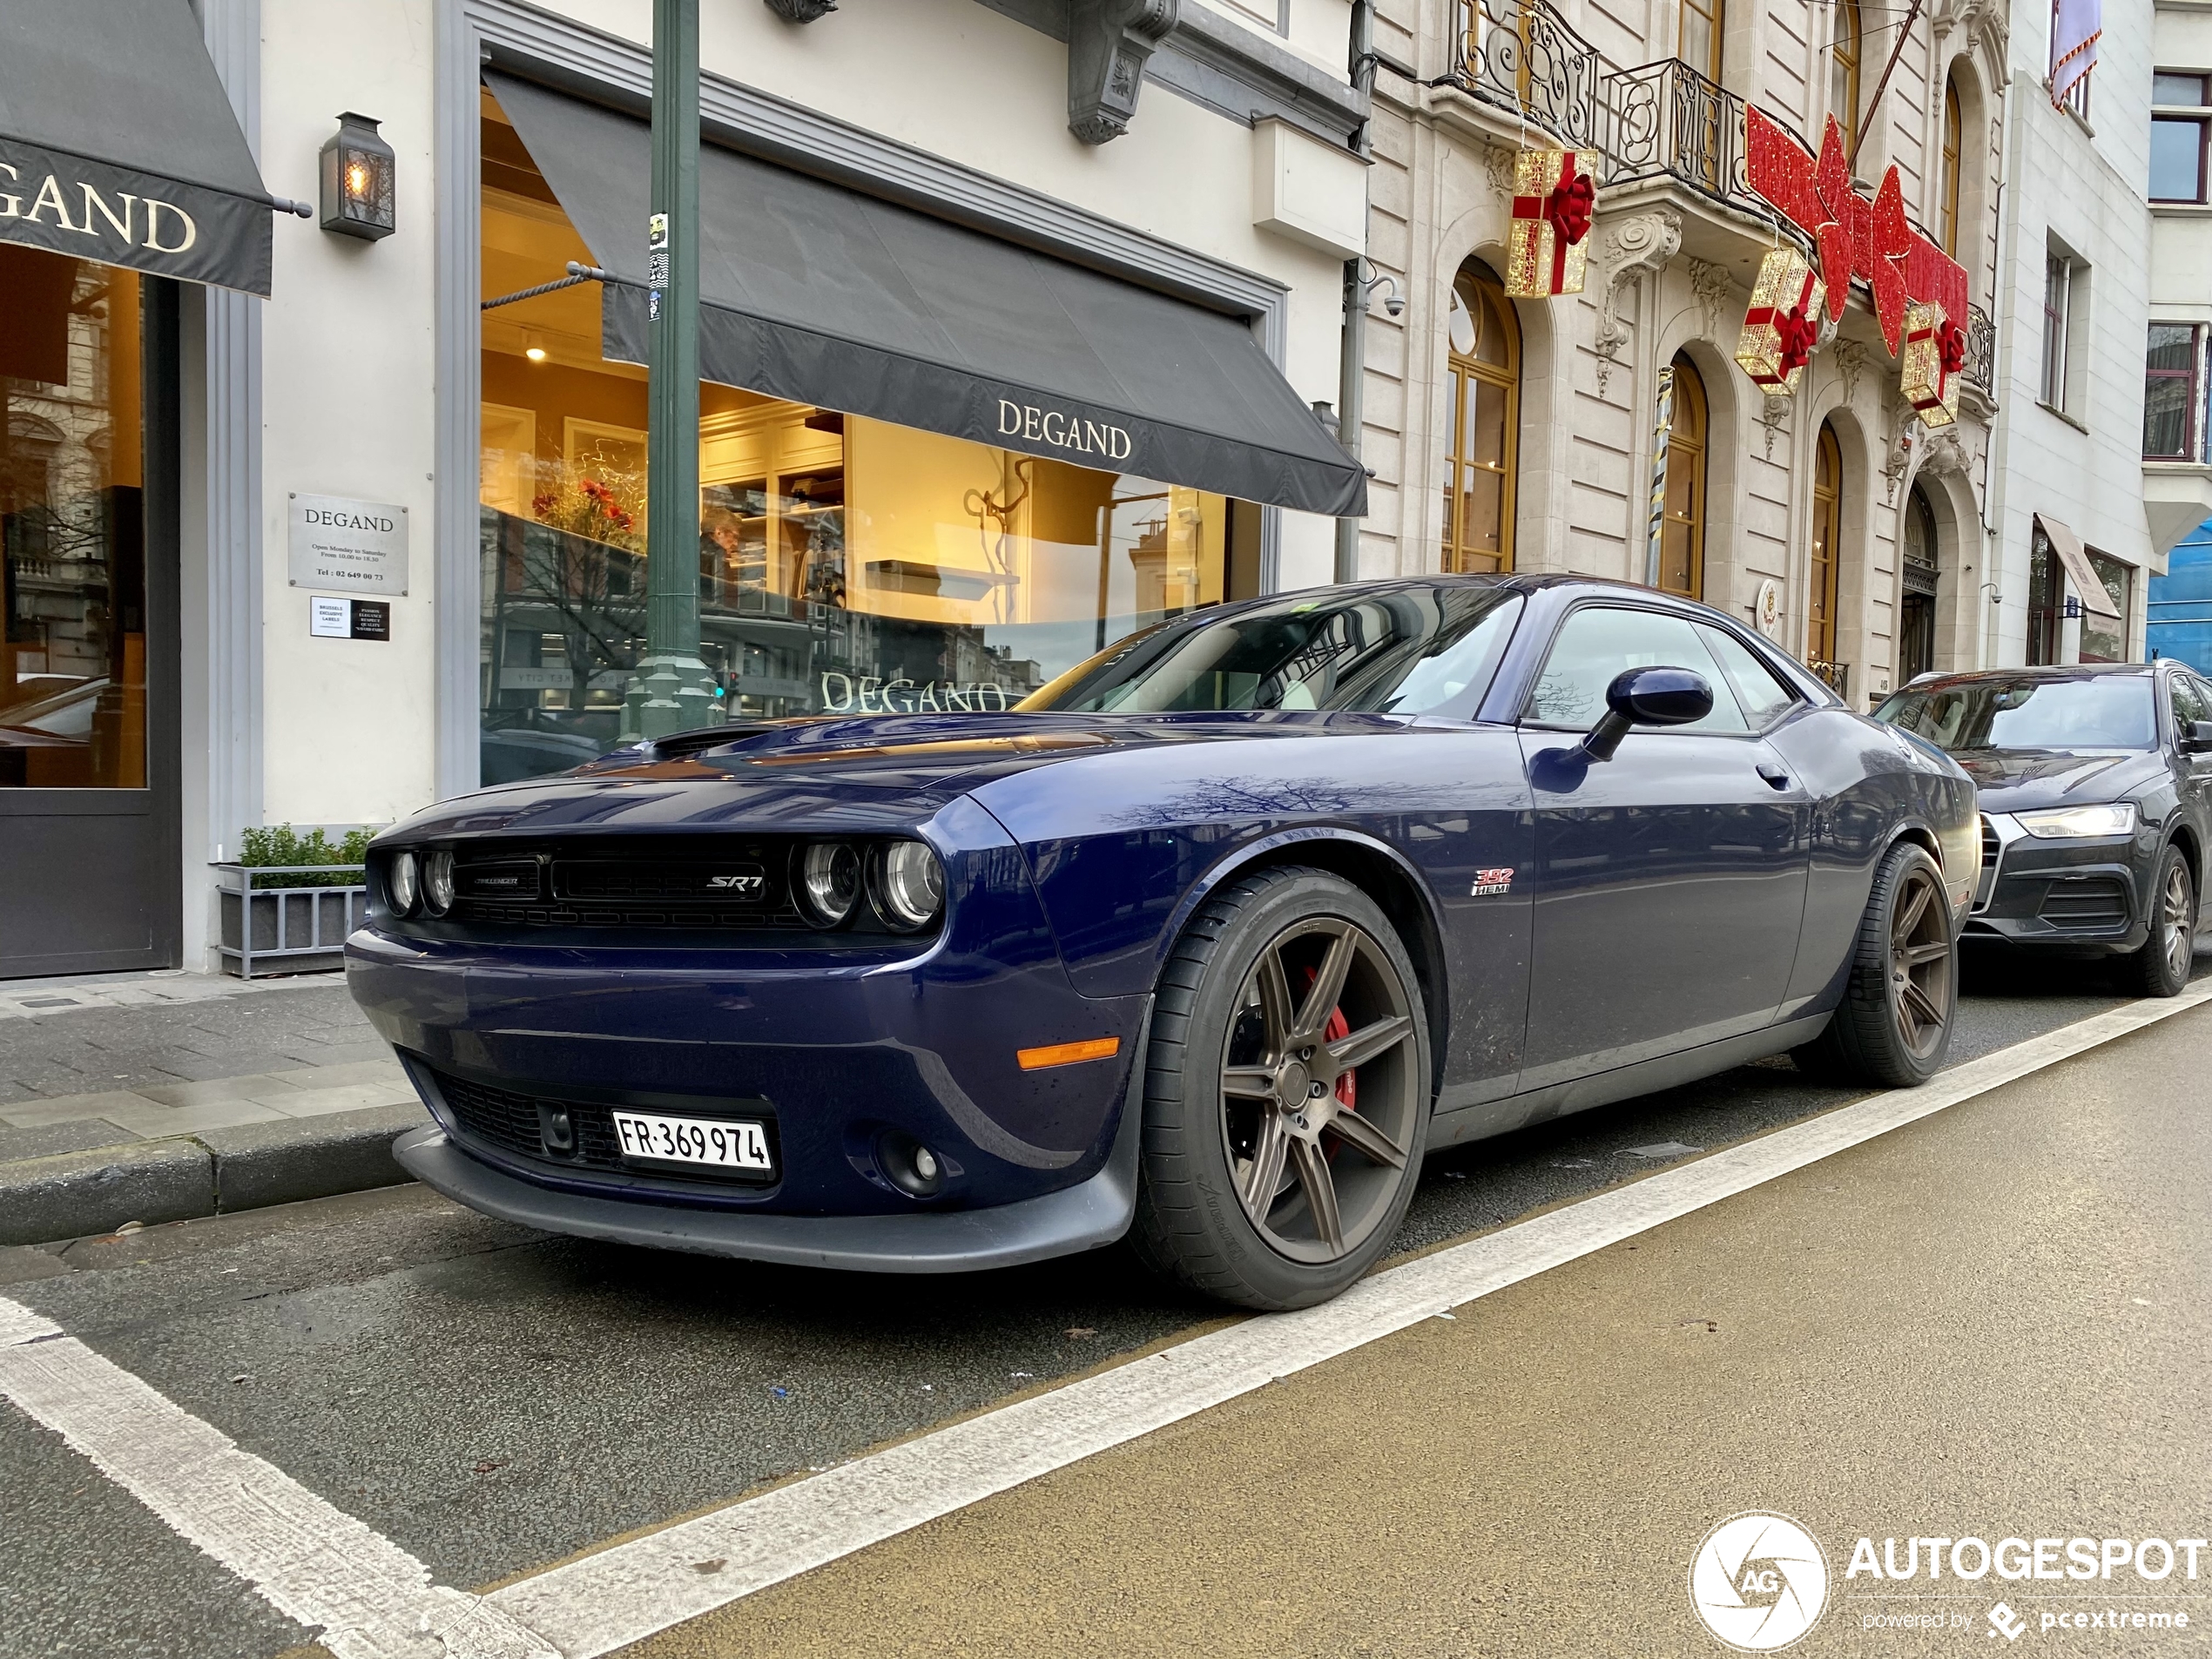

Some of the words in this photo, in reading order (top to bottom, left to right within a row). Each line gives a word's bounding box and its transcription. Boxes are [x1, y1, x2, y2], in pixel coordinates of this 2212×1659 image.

[998, 400, 1131, 459] DEGAND
[305, 509, 394, 532] DEGAND
[330, 545, 353, 554] Monday
[362, 549, 387, 557] Saturday
[822, 671, 1007, 712] DEGAND
[1474, 868, 1514, 885] 392
[1472, 884, 1510, 896] HEMI
